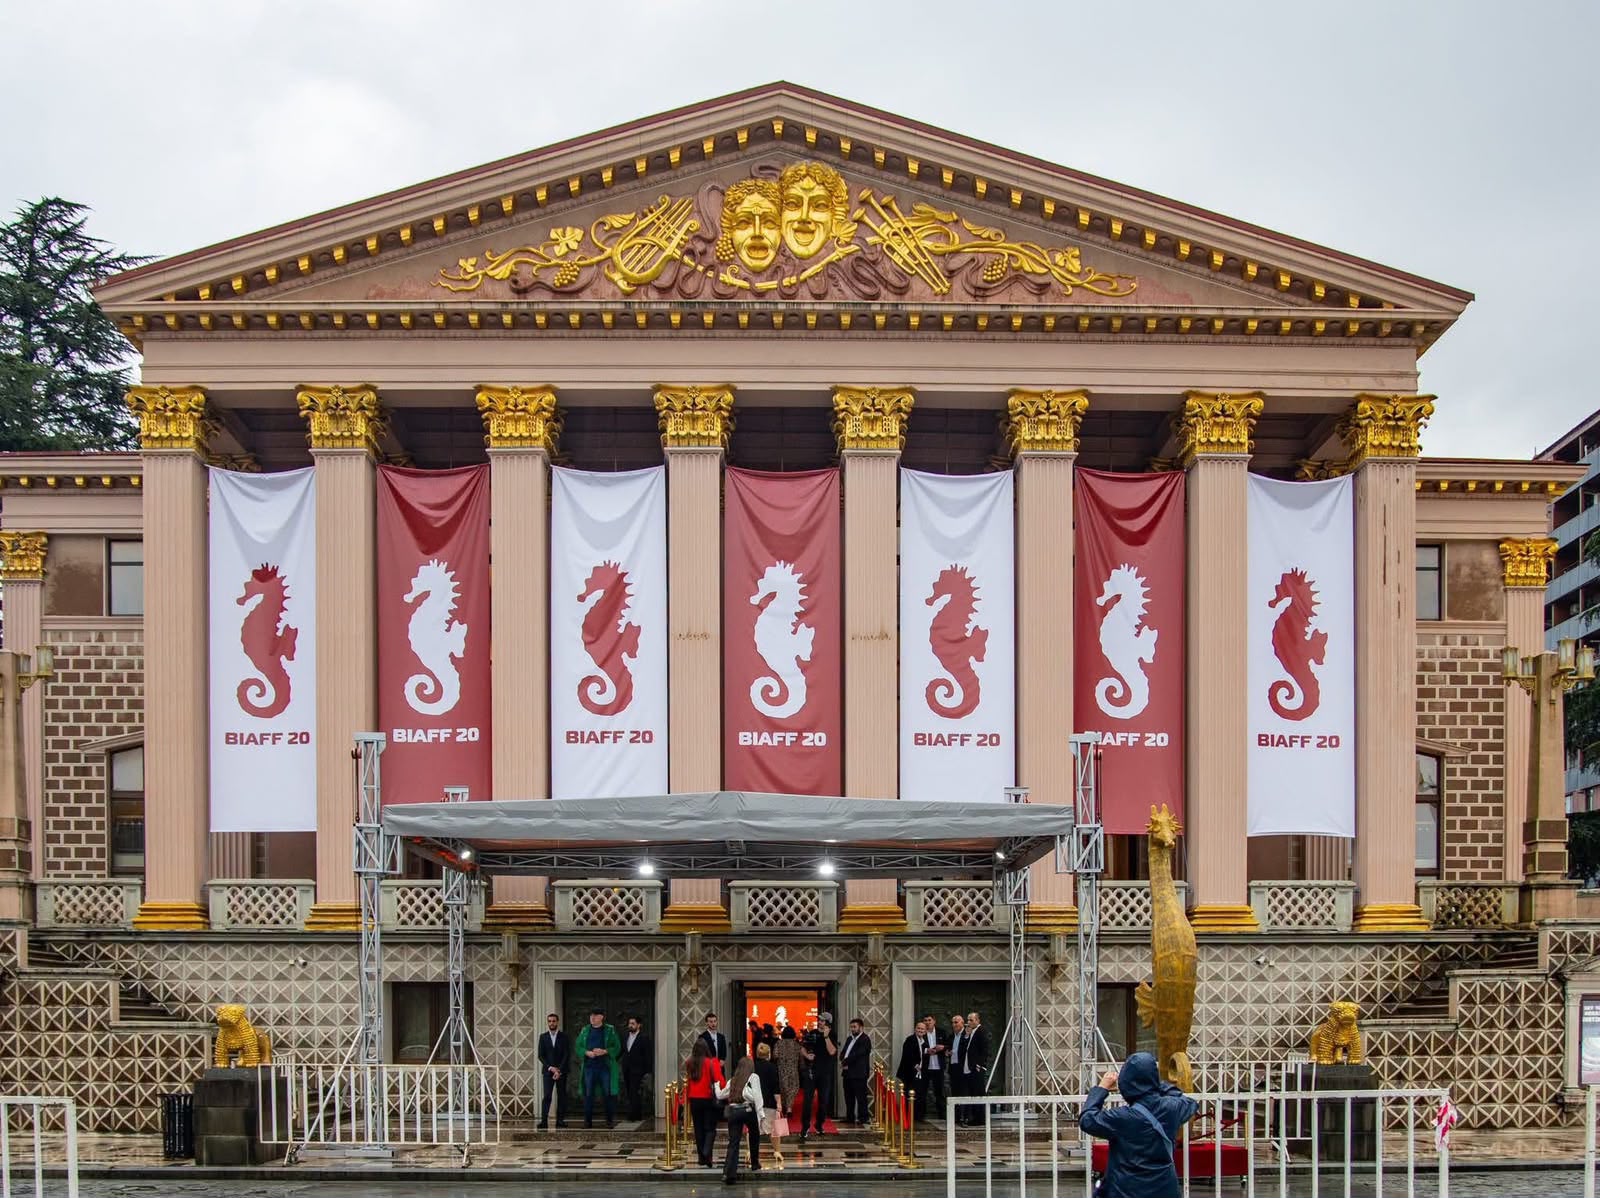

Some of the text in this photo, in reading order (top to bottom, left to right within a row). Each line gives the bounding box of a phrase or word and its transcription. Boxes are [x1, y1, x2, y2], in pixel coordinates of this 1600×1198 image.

[225, 731, 311, 746] BIAFF 20
[392, 727, 480, 743] BIAFF 20
[565, 730, 654, 745] BIAFF 20
[738, 731, 827, 747] BIAFF 20
[913, 732, 1001, 747] BIAFF 20
[1144, 732, 1169, 747] 20
[1257, 733, 1341, 749] BIAFF 20
